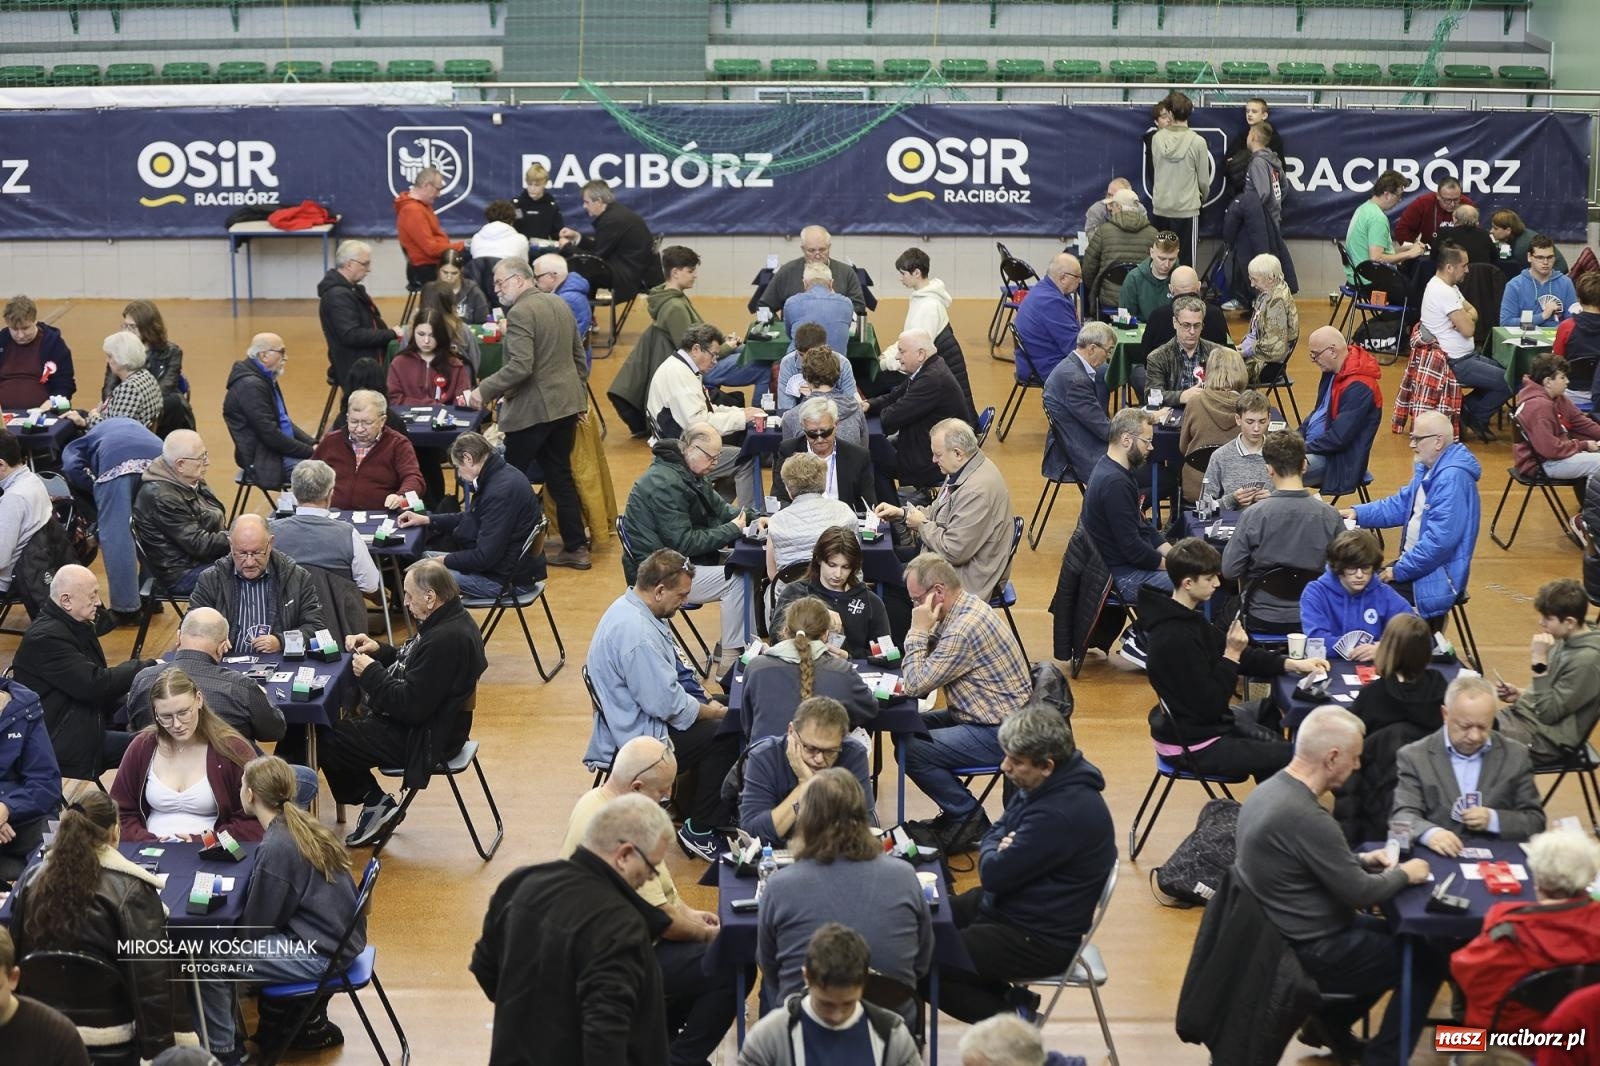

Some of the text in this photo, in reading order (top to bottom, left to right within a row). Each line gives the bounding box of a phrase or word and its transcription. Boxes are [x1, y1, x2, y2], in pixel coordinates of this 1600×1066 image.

[137, 141, 279, 188] OSiR
[522, 141, 774, 189] RACIBÓRZ
[886, 136, 1031, 185] OSiR
[194, 188, 280, 206] RACIBÓRZ
[944, 186, 1031, 204] RACIBÓRZ
